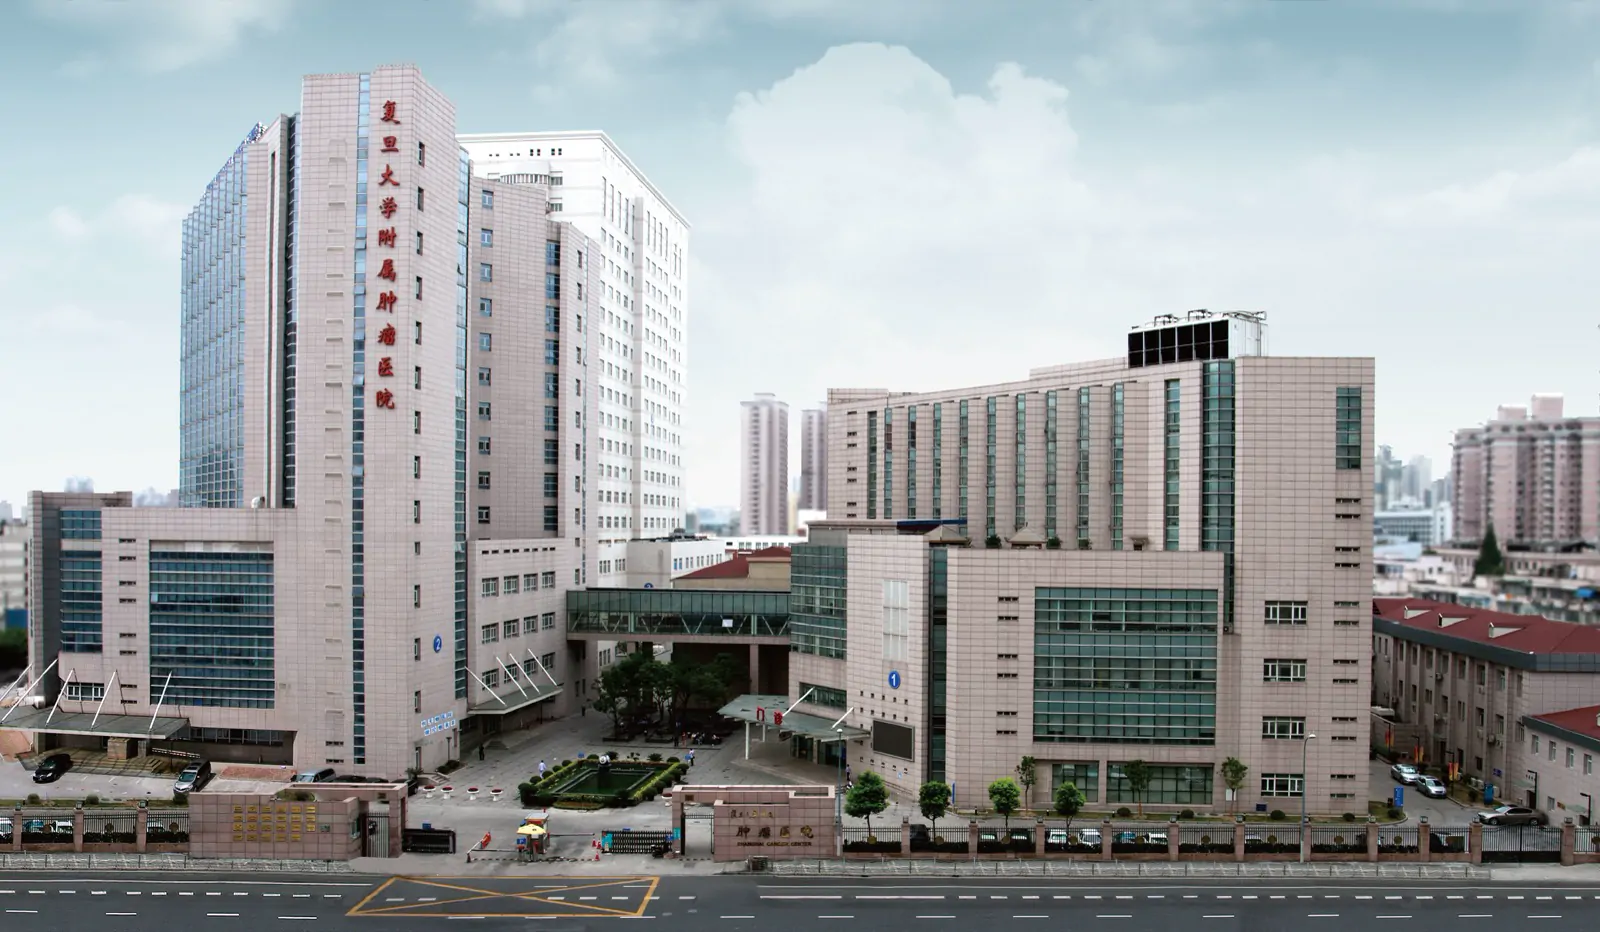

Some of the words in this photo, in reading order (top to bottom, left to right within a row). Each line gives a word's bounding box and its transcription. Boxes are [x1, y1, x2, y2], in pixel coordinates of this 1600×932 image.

[376, 99, 401, 409] 复旦大学附属肿瘤医院
